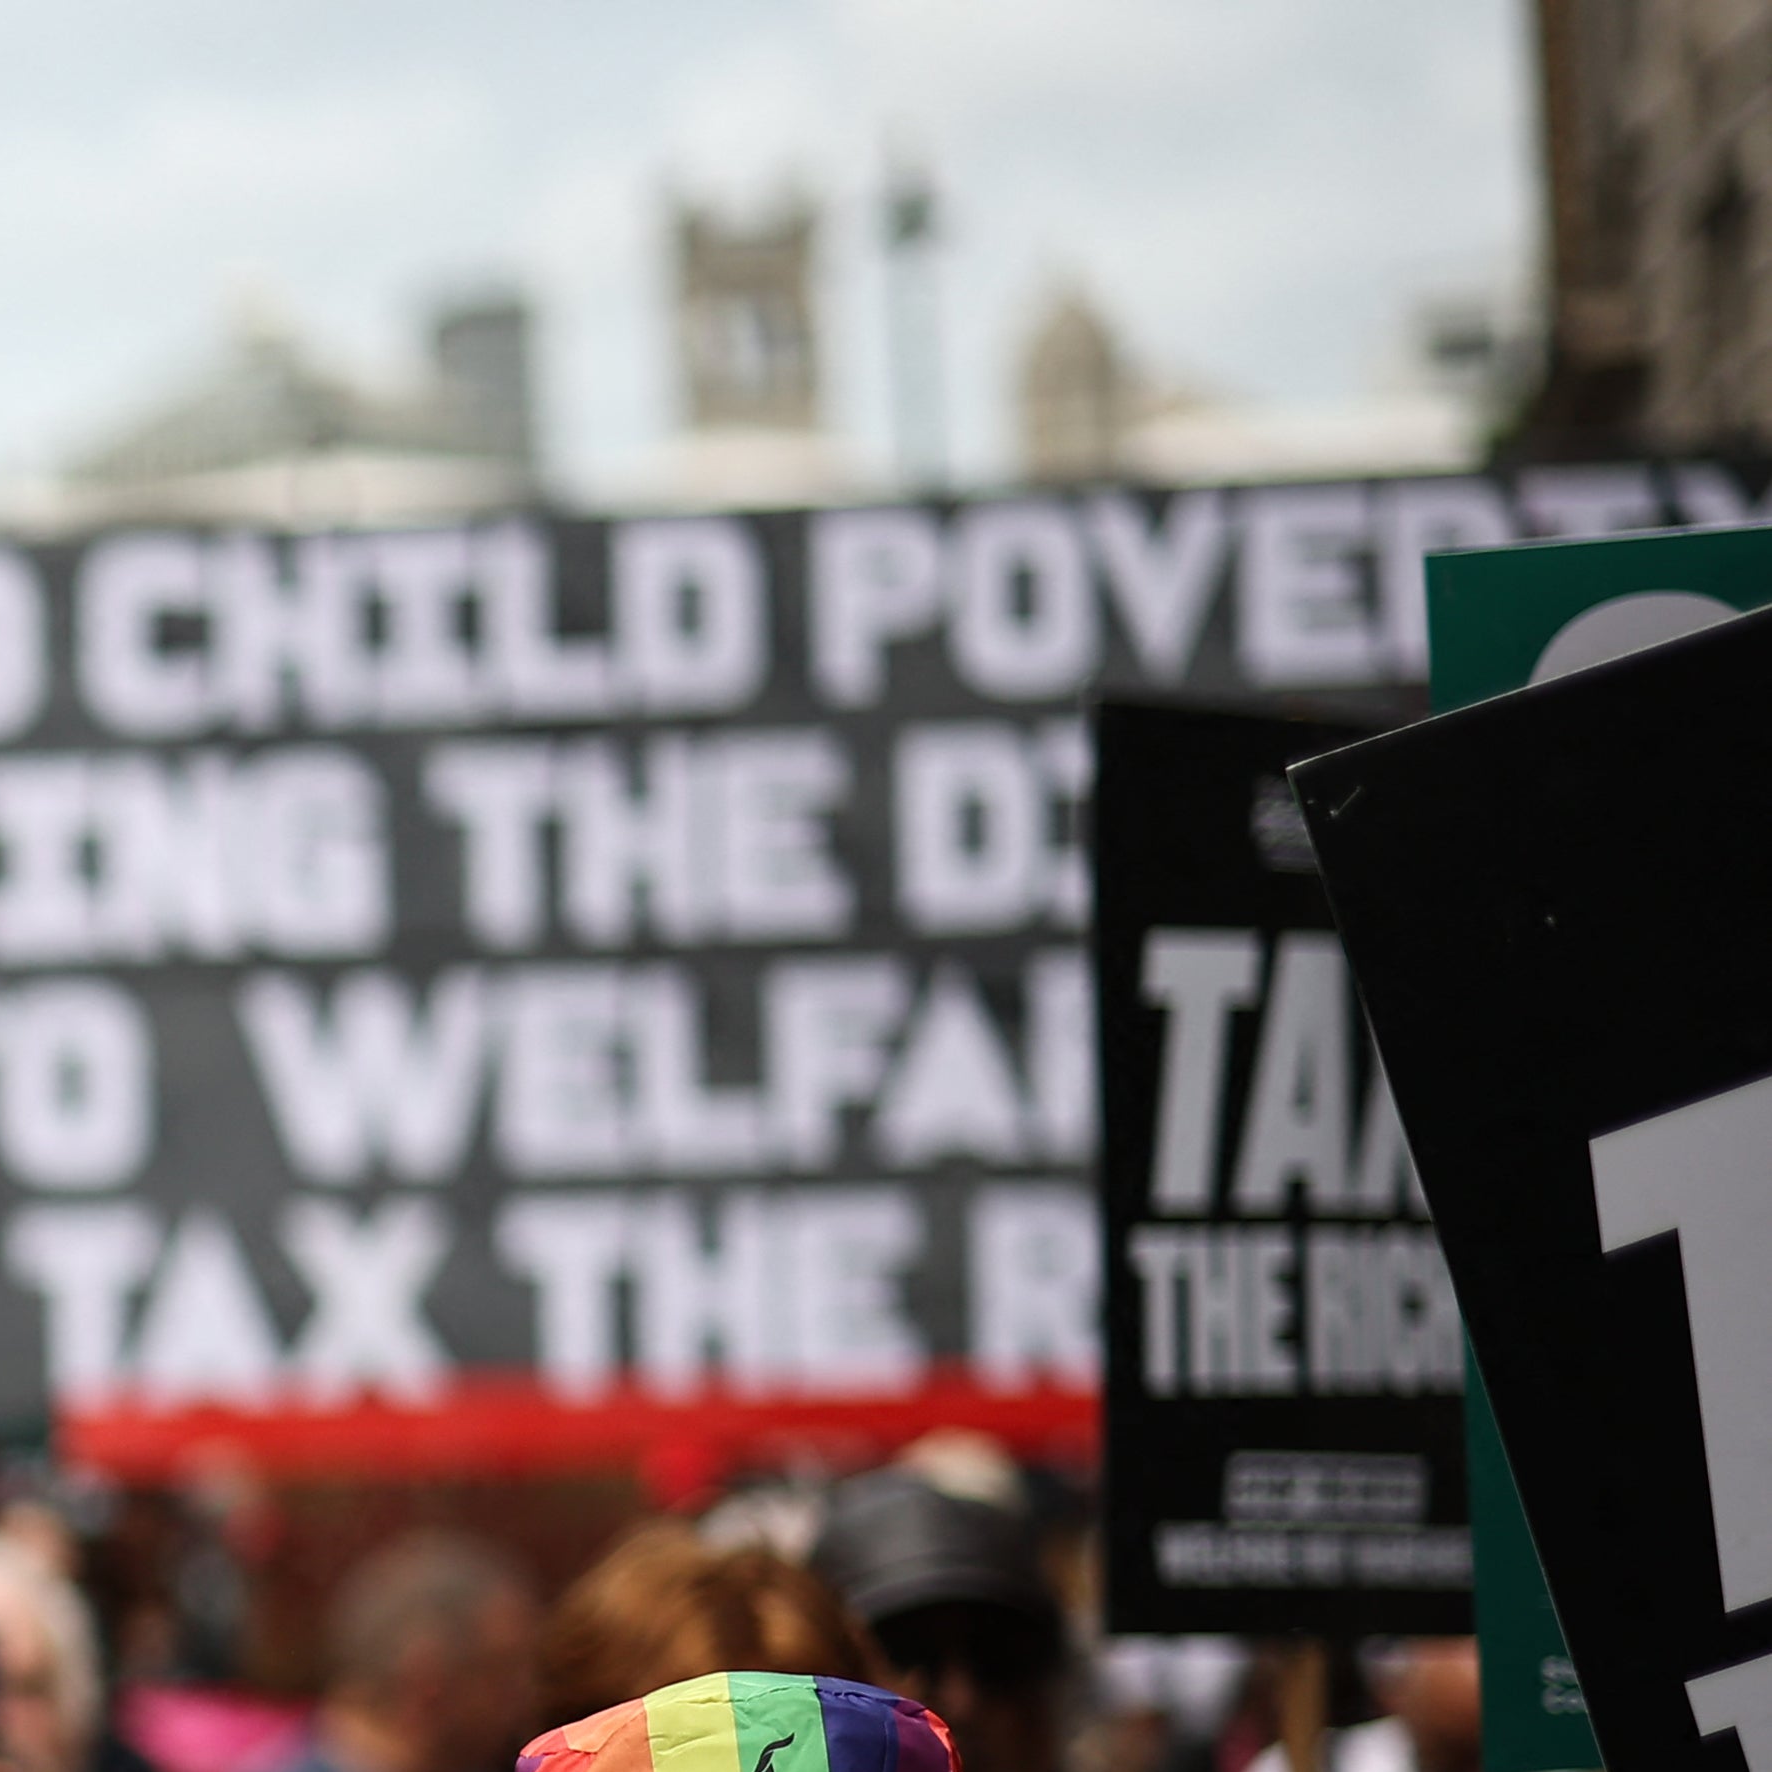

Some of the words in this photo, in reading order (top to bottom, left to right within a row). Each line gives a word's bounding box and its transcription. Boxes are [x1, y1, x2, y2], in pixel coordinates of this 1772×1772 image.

[75, 518, 767, 738] CHILD
[425, 722, 853, 950] THE
[3, 1204, 451, 1400] TAX
[499, 1192, 923, 1398] THE
[1129, 1223, 1296, 1398] THE
